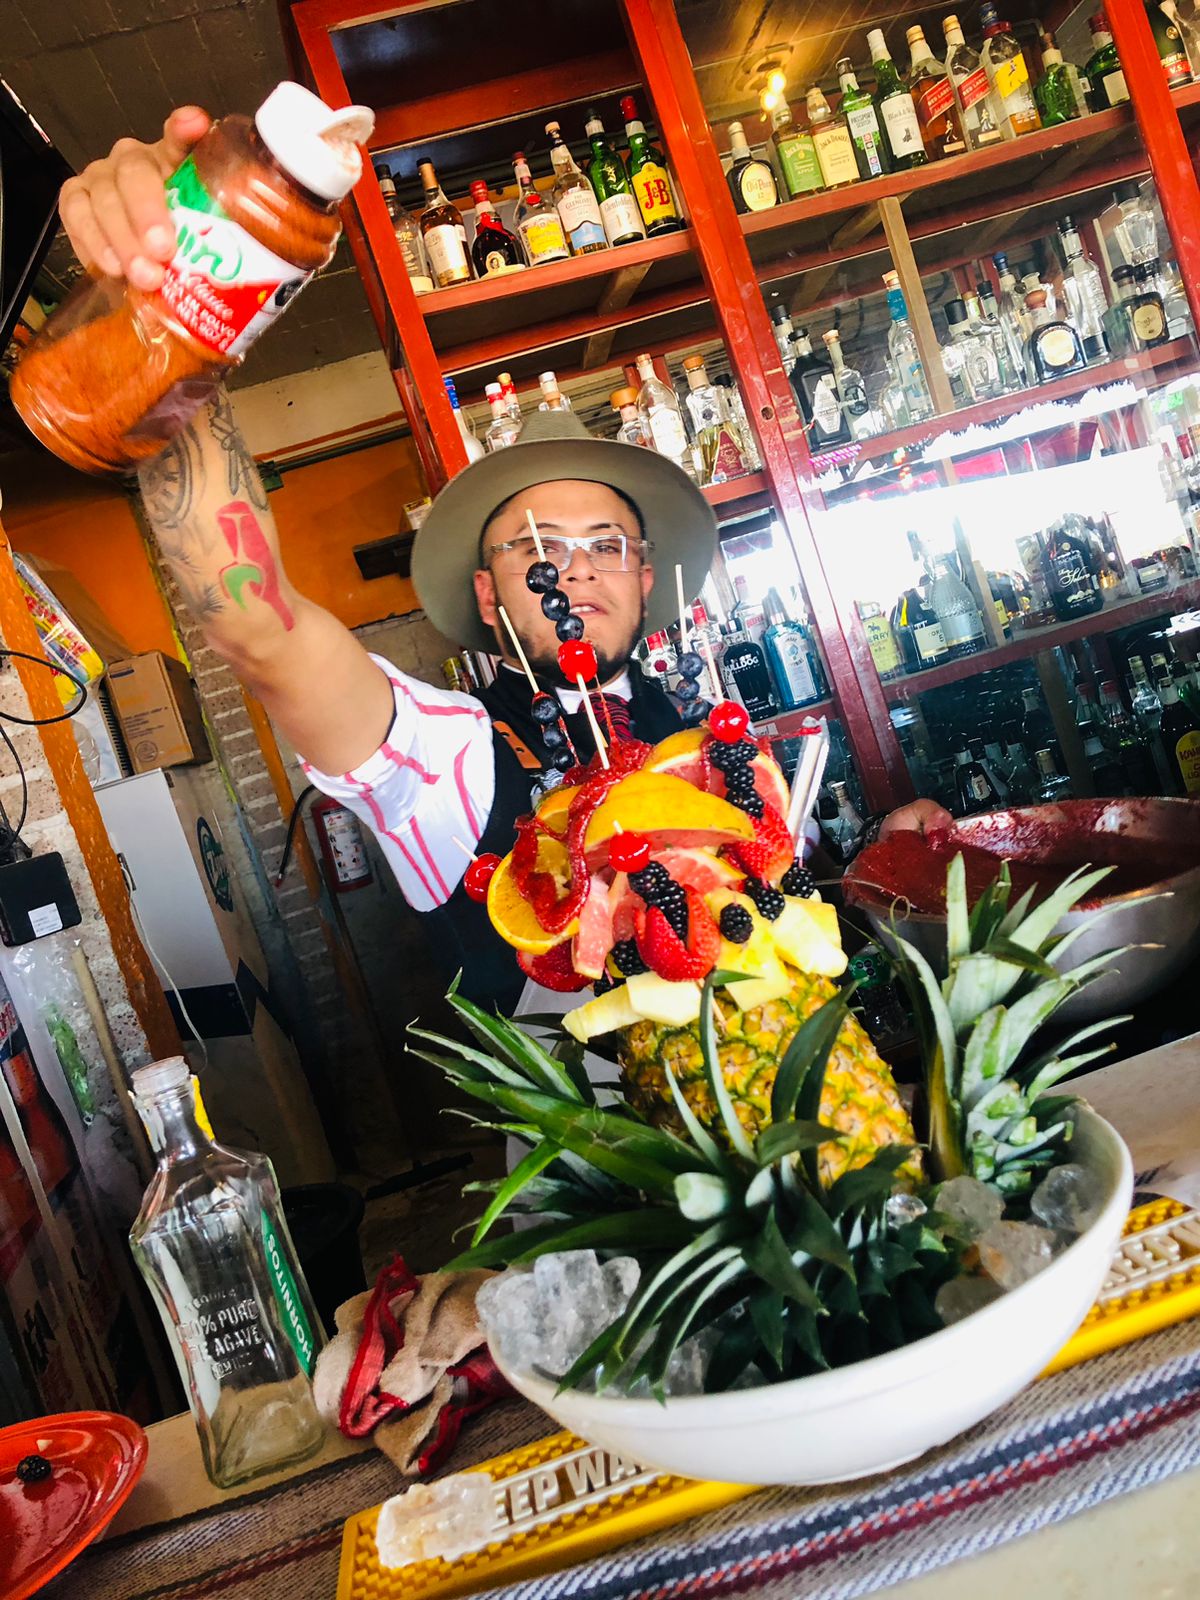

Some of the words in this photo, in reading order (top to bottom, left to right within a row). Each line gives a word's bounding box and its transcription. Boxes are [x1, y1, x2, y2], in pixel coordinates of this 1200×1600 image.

[267, 1233, 312, 1363] HORNITOS
[212, 1325, 265, 1357] AGAVE
[492, 1467, 562, 1526] EEP
